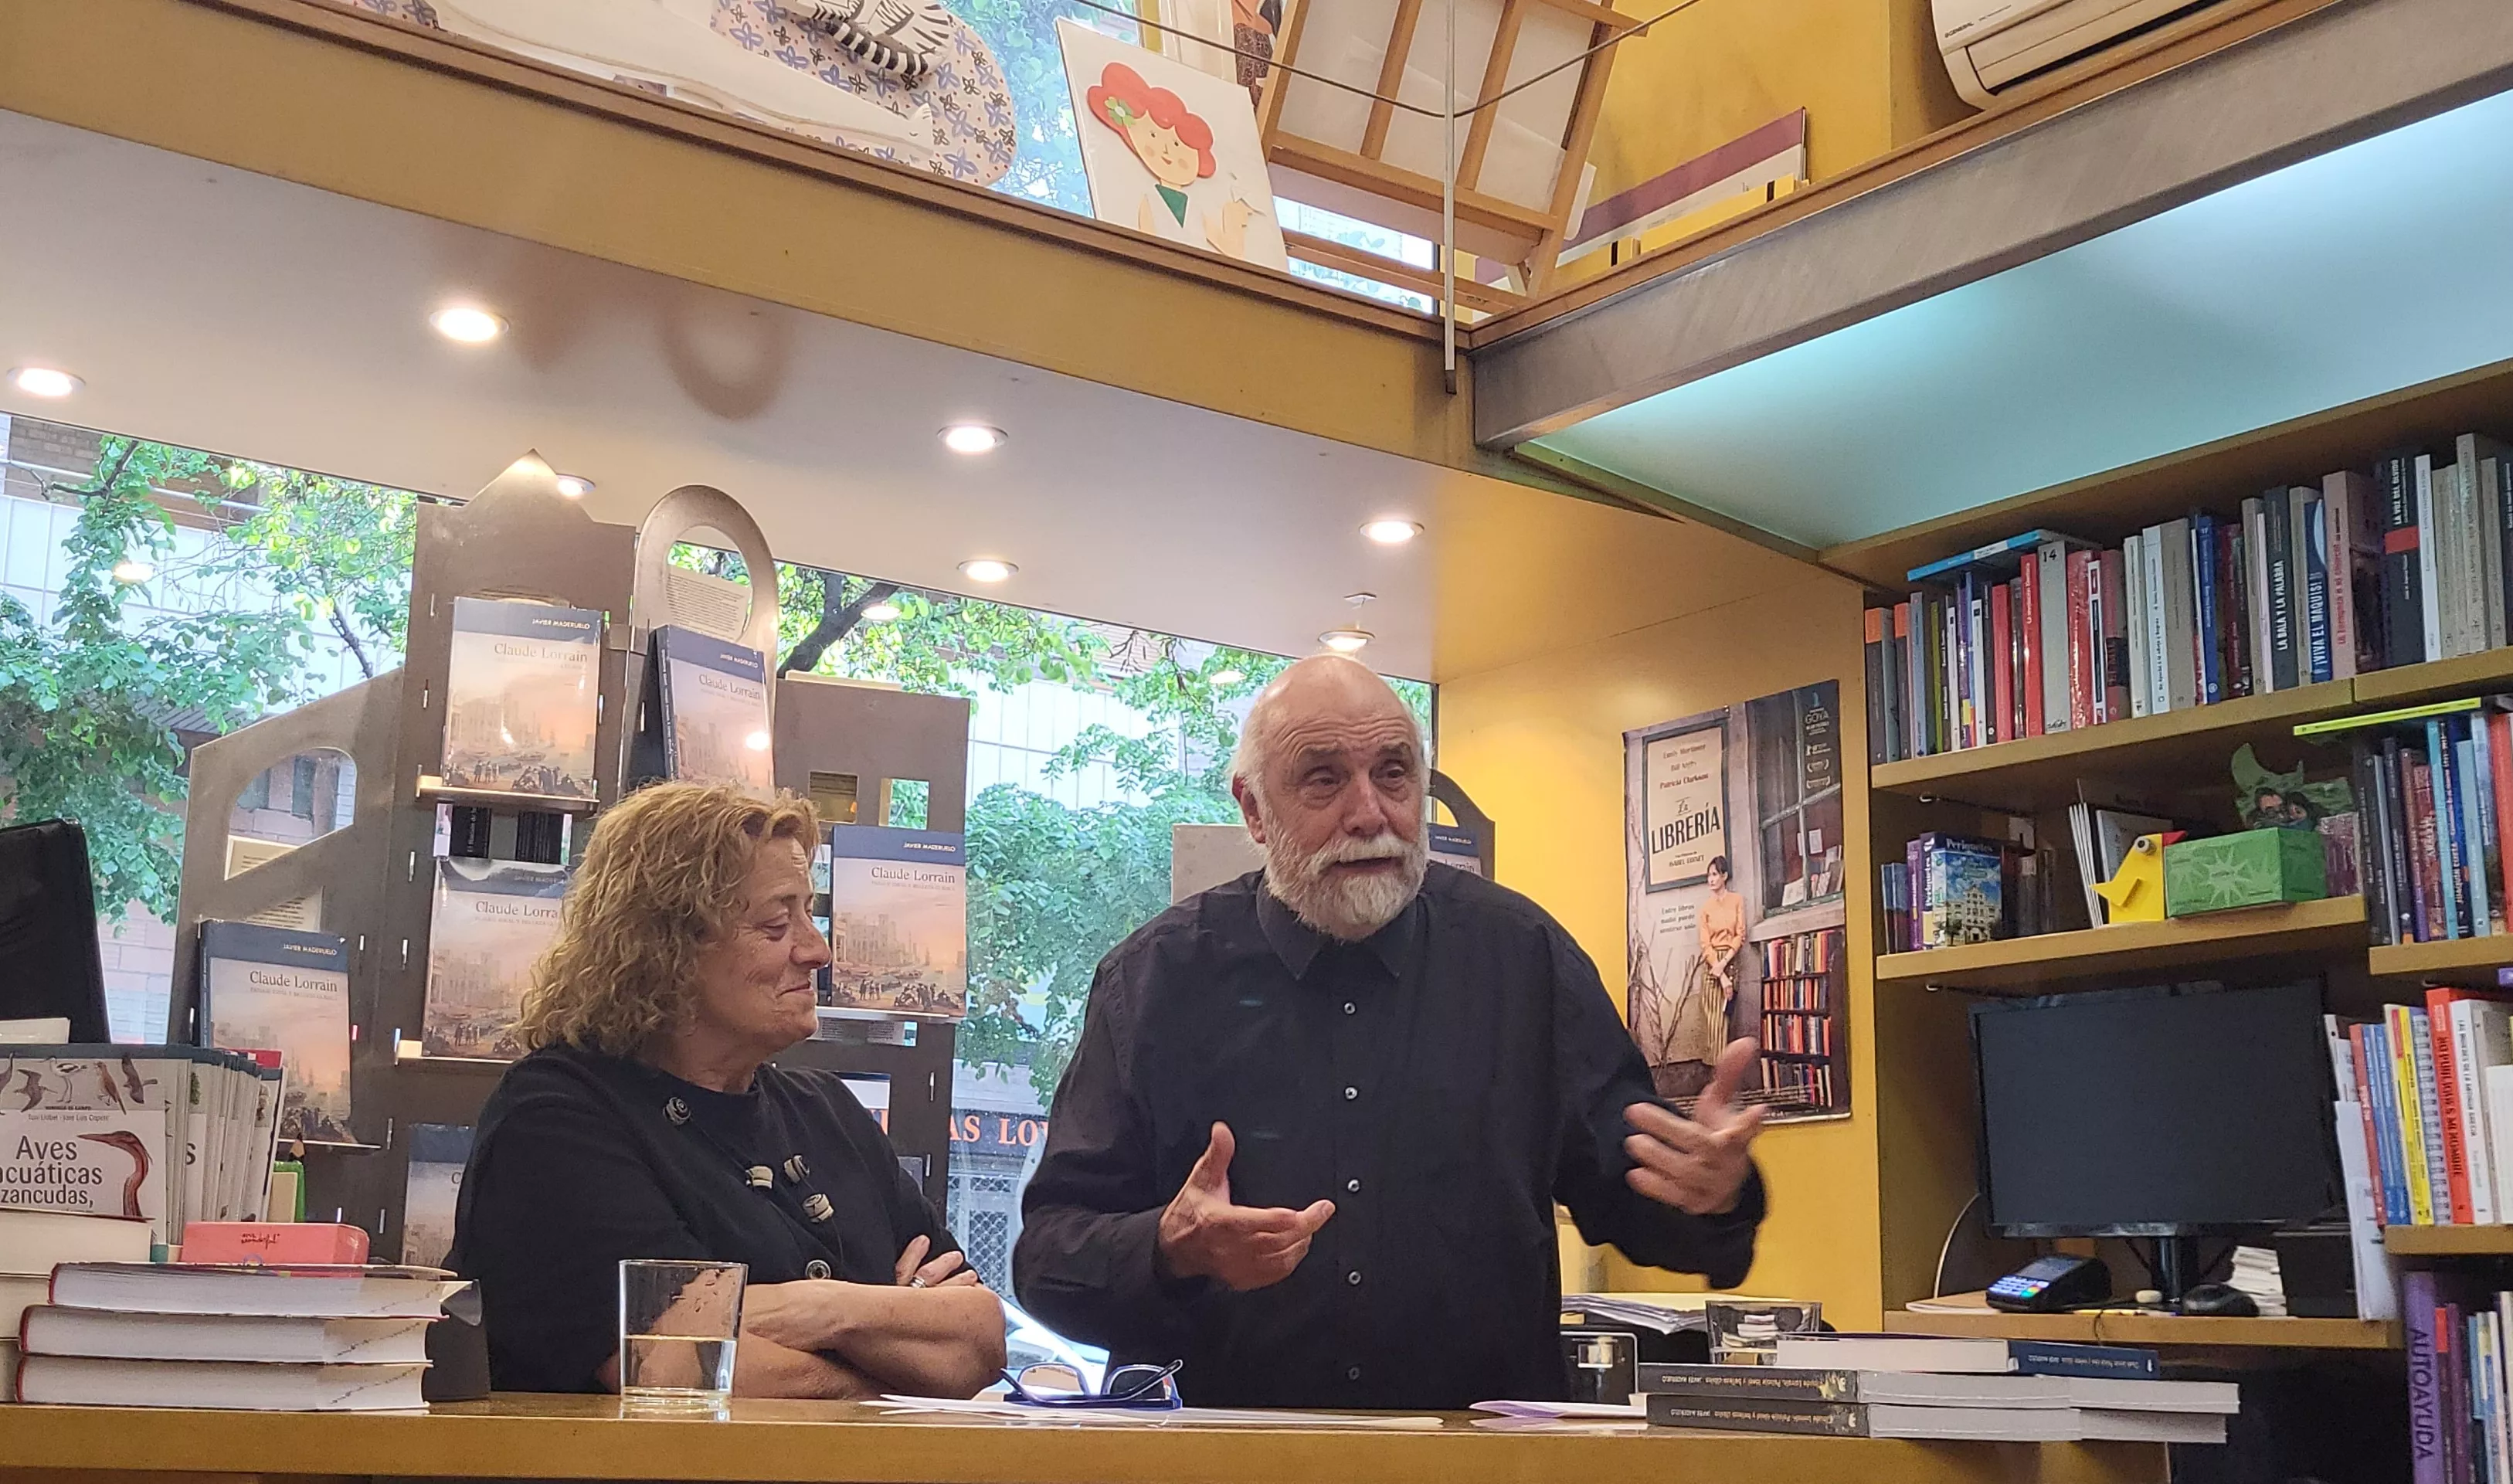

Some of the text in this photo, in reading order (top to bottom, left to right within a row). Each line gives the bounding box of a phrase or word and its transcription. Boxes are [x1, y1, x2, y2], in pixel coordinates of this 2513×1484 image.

[2043, 549, 2056, 562] 14
[2274, 560, 2285, 596] PALABRA
[2275, 597, 2286, 609] LA
[2277, 616, 2287, 639] BALA
[2311, 624, 2325, 637] EL
[494, 643, 588, 662] Claude Lorrain
[2277, 639, 2287, 650] LA
[699, 674, 727, 691] Claude
[730, 682, 760, 700] Lorrain
[1659, 777, 1682, 790] Patricia
[1652, 802, 1720, 854] LIBRERÍA
[871, 867, 955, 884] Claude Lorrain
[475, 901, 558, 918] Claude Lorra
[250, 970, 337, 993] Claude Lorrain
[15, 1135, 78, 1161] Aves
[2449, 1132, 2462, 1175] NOMBRE
[0, 1184, 94, 1208] zancudas,
[2410, 1329, 2435, 1459] AUTOAYUDA
